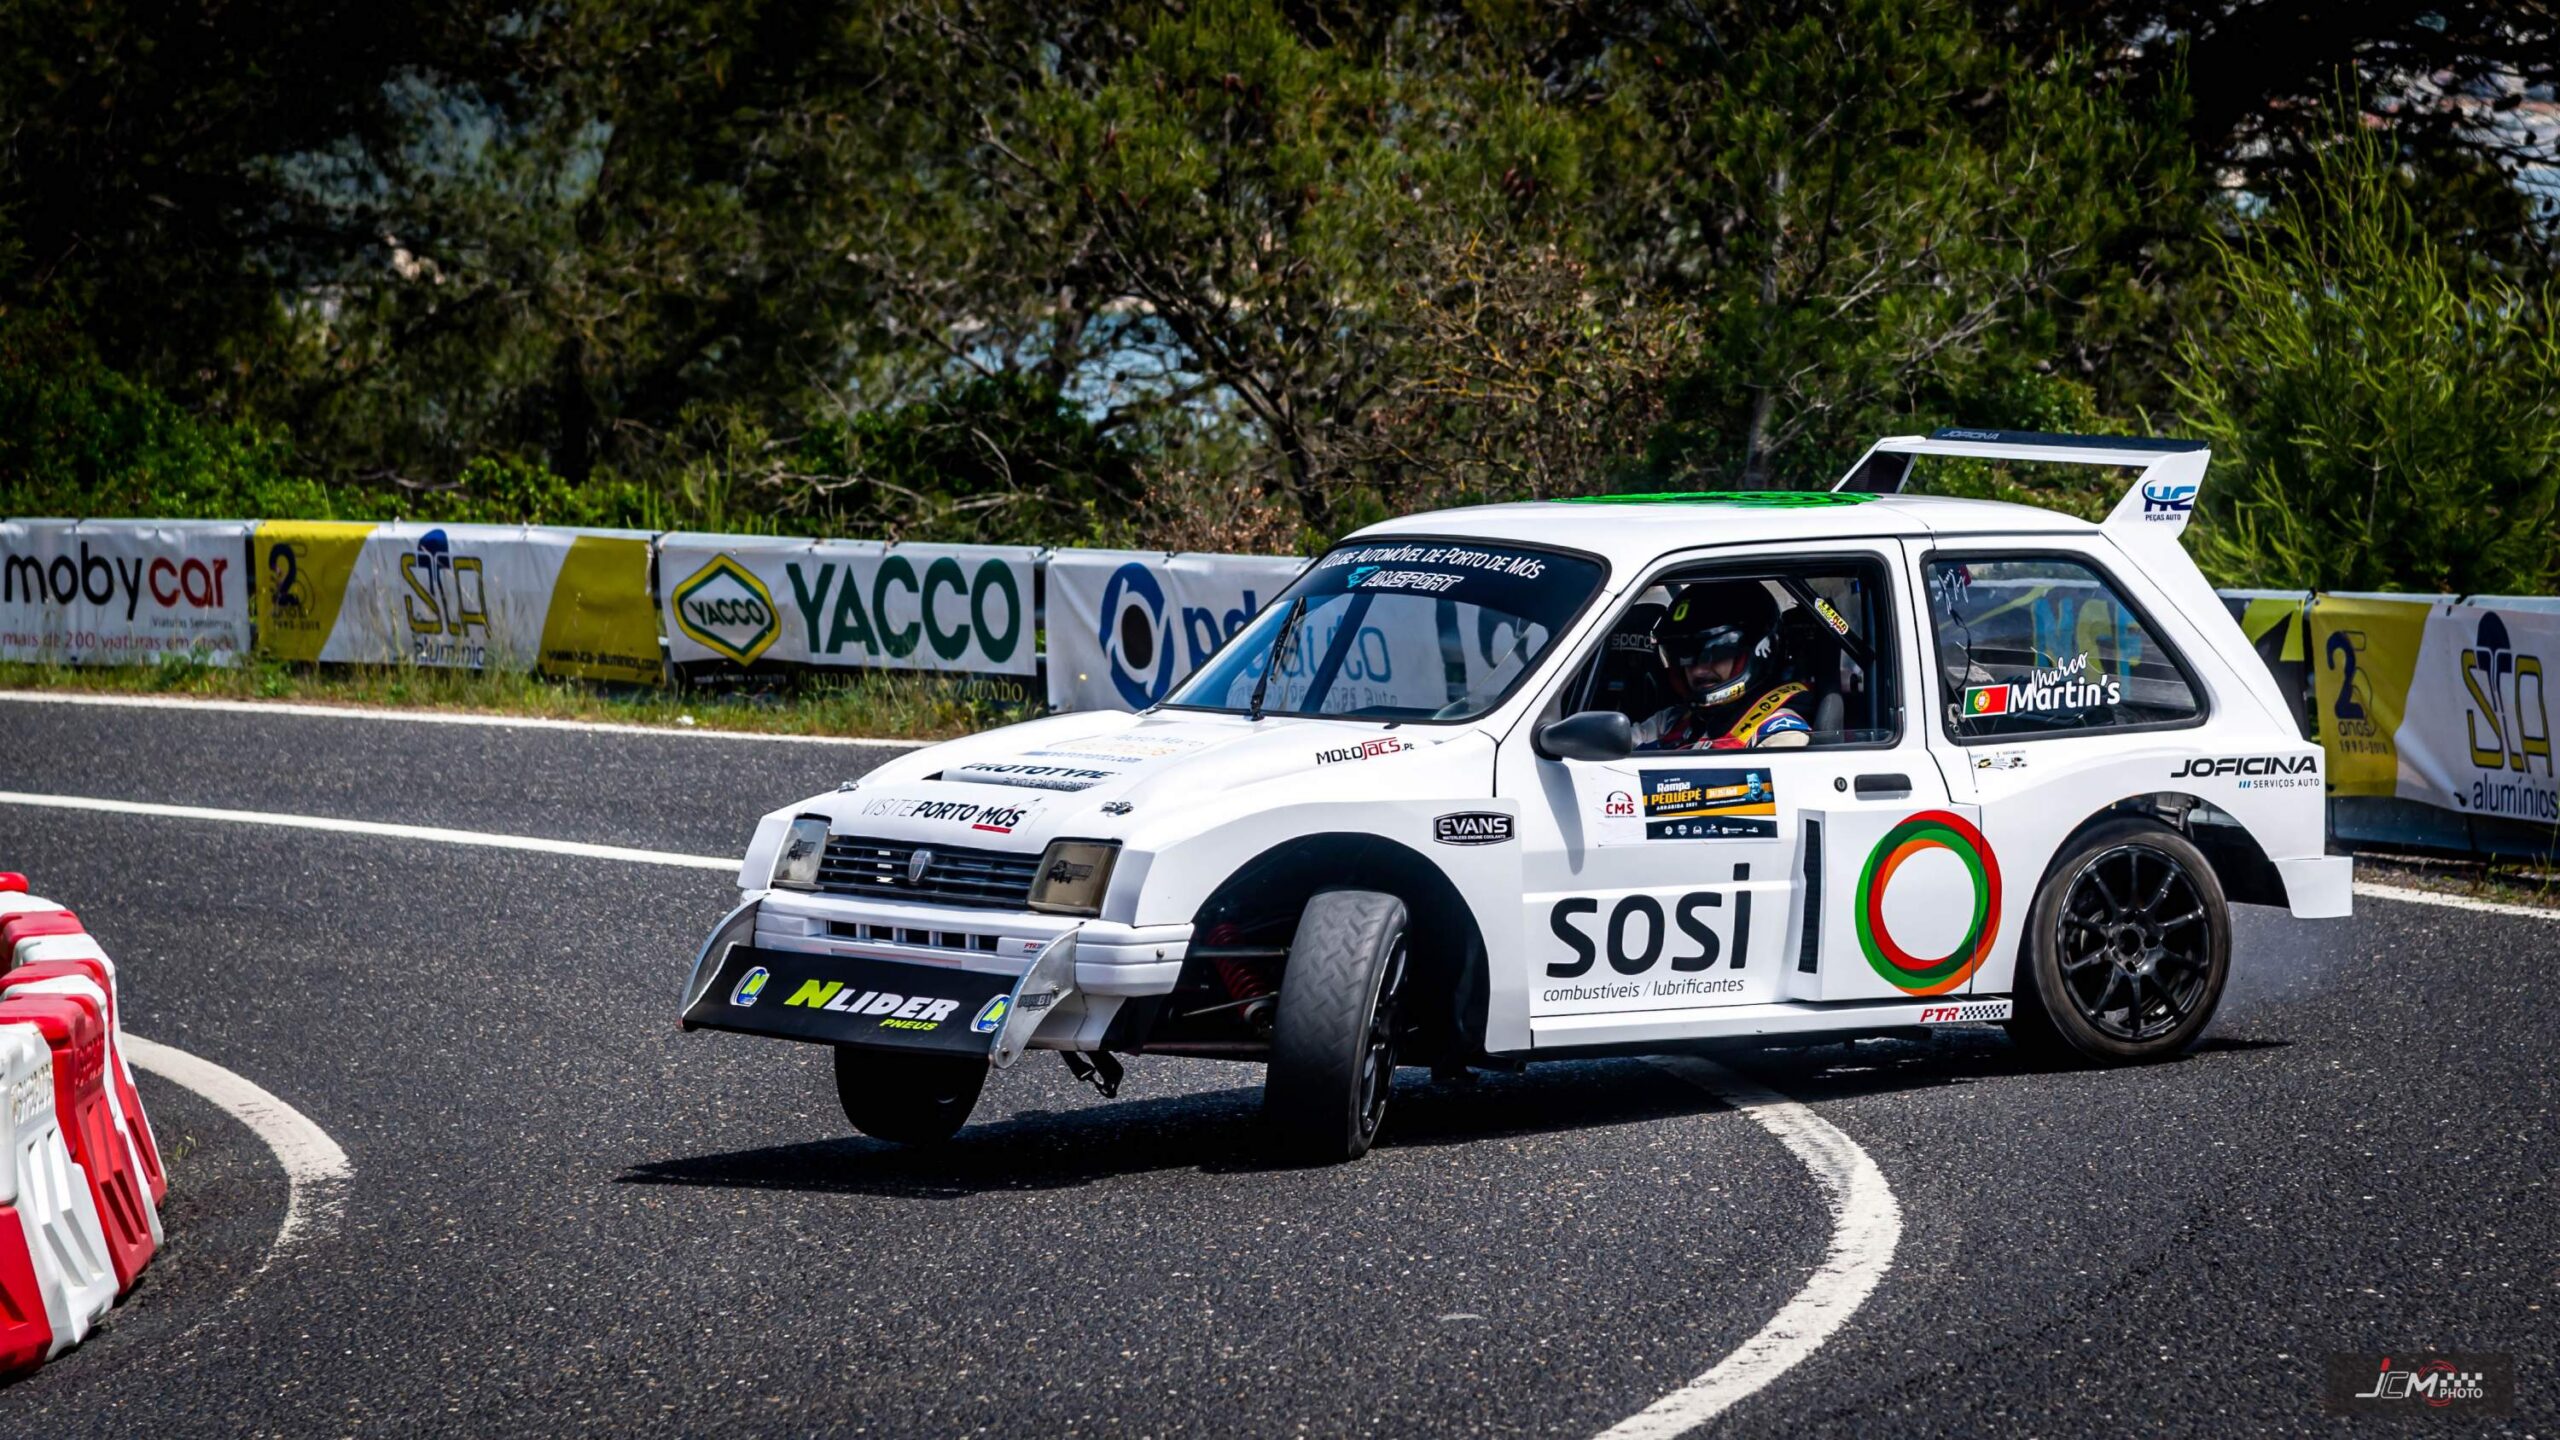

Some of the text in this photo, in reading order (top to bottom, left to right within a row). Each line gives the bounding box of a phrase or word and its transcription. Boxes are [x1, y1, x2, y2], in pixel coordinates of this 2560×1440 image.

[2166, 513, 2182, 521] AUTO
[1351, 544, 1424, 563] AUTOMÓVEL
[1422, 549, 1446, 562] DE
[1440, 548, 1486, 568] PORTO
[1484, 553, 1513, 571] DE
[1504, 556, 1546, 579] MÓS
[4, 541, 228, 621] mobycar
[689, 597, 760, 626] YACCO
[785, 555, 1021, 664] YACCO
[65, 631, 96, 649] 200
[2010, 674, 2121, 713] Martin's
[961, 762, 1114, 779] PROTOTYPE
[2171, 756, 2318, 778] JOFICINA
[1657, 781, 1691, 793] Rampa
[2253, 778, 2320, 788] SERVIÇOS AUTO
[2472, 774, 2560, 820] alumínios
[909, 801, 981, 822] PORTO
[1605, 803, 1635, 815] CMS
[1438, 817, 1509, 835] EVANS
[1543, 981, 1641, 1002] combustíveis
[1652, 979, 1745, 997] lubrificantes
[1920, 1007, 1960, 1022] PTR
[880, 1018, 942, 1032] PNEUS
